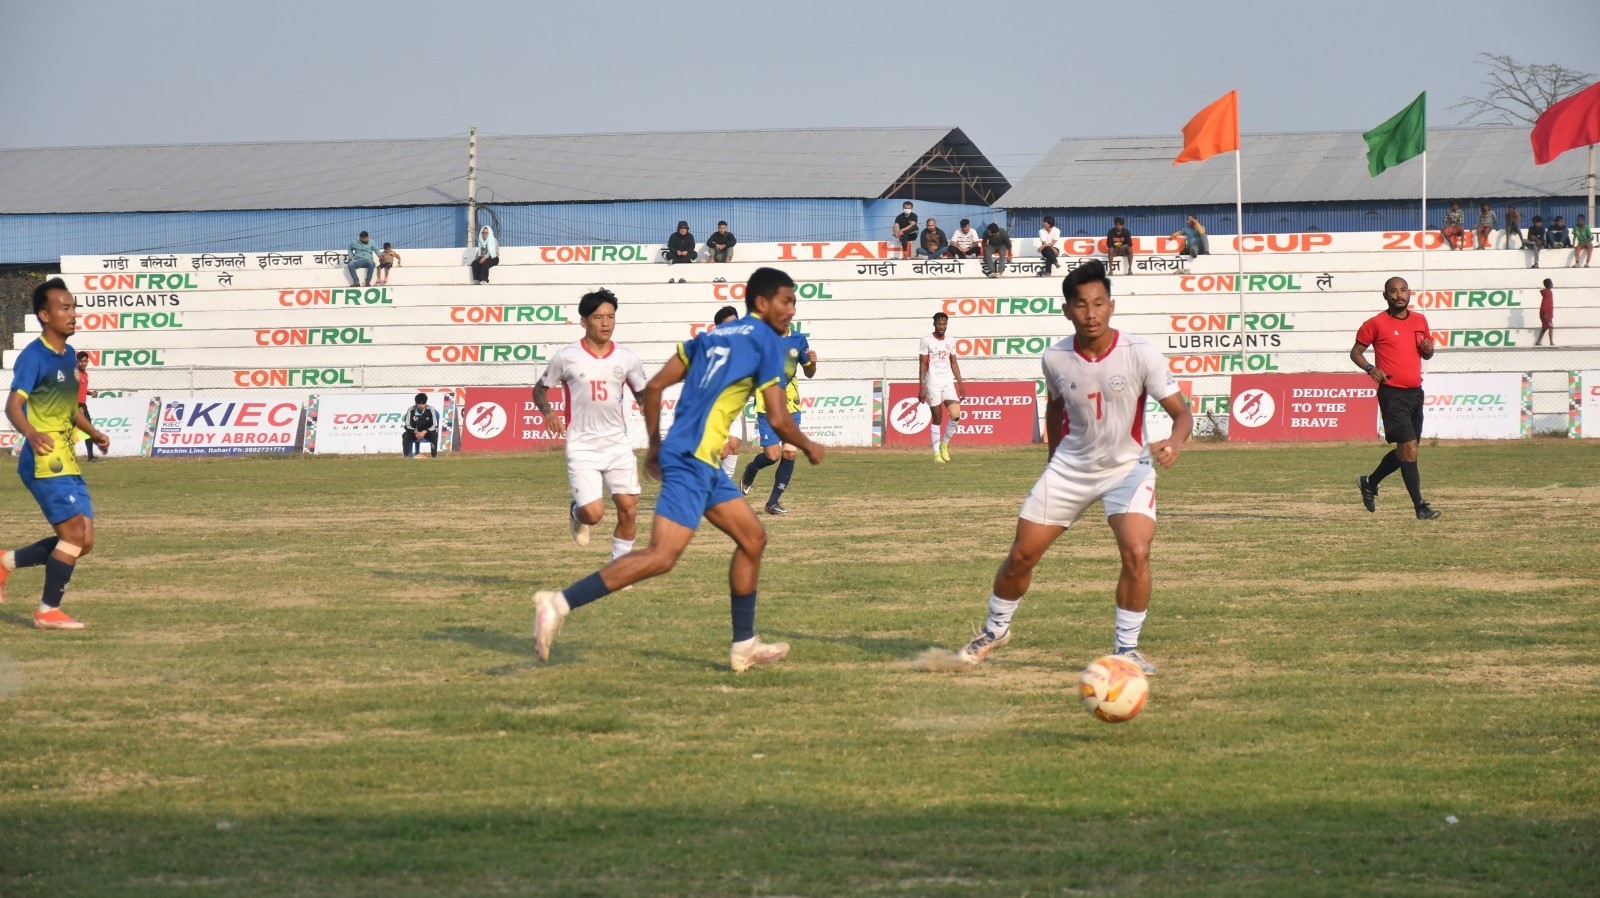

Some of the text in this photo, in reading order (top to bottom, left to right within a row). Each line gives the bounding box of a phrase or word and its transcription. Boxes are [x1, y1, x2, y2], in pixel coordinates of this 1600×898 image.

[1233, 233, 1333, 252] CUP
[540, 245, 648, 263] CONTROL
[83, 273, 198, 291] CONTROL
[1180, 274, 1302, 292] CONTROL
[74, 294, 180, 307] LUBRICANTS
[278, 287, 393, 306] CONTROL
[450, 305, 567, 323] CONTROL
[942, 297, 1064, 316] CONTROL
[1170, 313, 1295, 332] CONTROL
[254, 327, 373, 345] CONTROL
[1168, 334, 1281, 348] LUBRICANTS
[1432, 330, 1516, 347] NTROL
[425, 344, 546, 362] CONTROL
[938, 350, 946, 360] 12
[956, 337, 1052, 356] ONTRO
[87, 350, 165, 367] NTROL
[699, 345, 731, 389] 17
[1168, 354, 1279, 373] CONTROL
[234, 368, 353, 387] CONTROL
[589, 380, 608, 401] 15
[1293, 388, 1377, 399] DEDICATED
[801, 395, 864, 408] NTROL
[960, 396, 1032, 406] EDICATED
[1087, 391, 1104, 420] 7
[1292, 403, 1346, 413] TO THE
[1424, 394, 1505, 406] ONTROL
[187, 402, 298, 427] KIEC
[332, 413, 406, 424] CONTR
[523, 415, 543, 425] TO
[972, 411, 1001, 420] THE
[1291, 417, 1338, 428] BRAVE
[221, 433, 291, 444] ABROAD
[956, 425, 994, 434] RAVE
[159, 433, 216, 445] STUDY
[1146, 485, 1156, 509] 7
